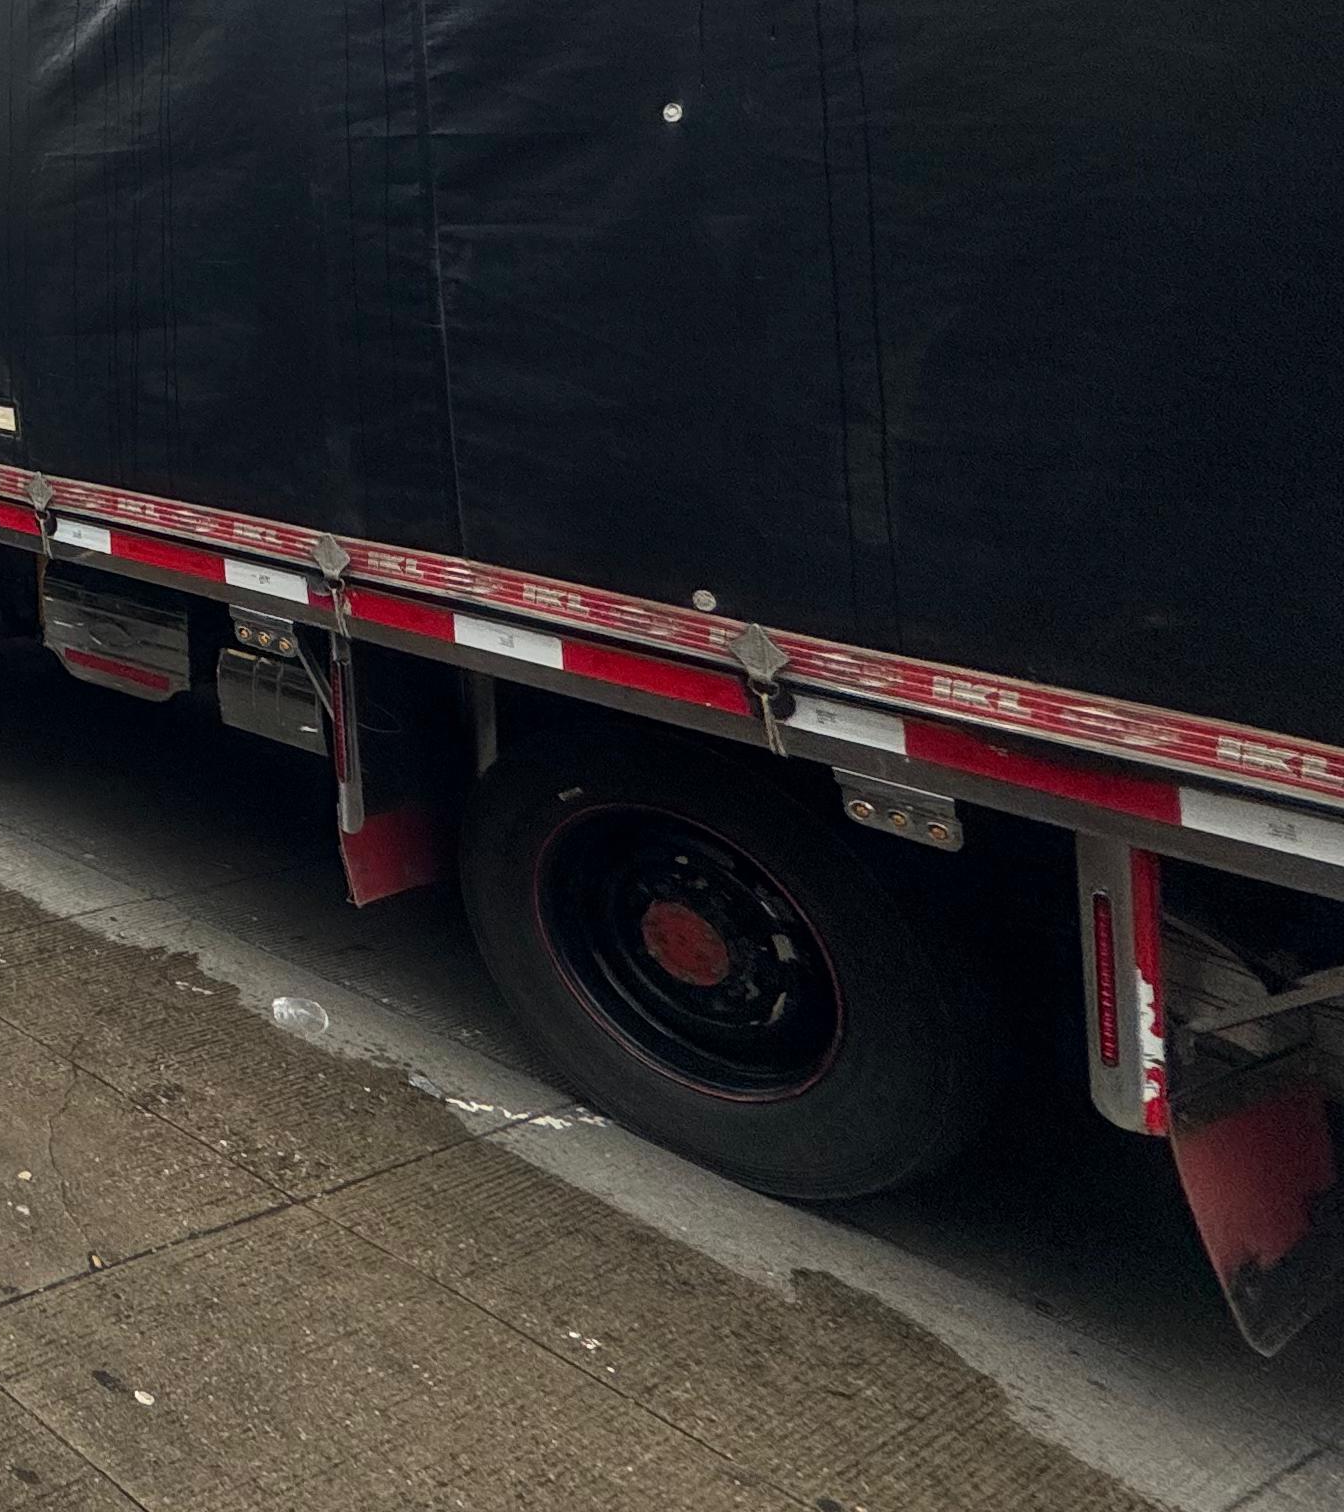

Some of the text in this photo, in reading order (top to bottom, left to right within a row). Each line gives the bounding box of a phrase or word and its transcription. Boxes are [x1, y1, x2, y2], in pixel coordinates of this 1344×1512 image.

[368, 551, 424, 580] IKL
[523, 583, 590, 616] IKL
[933, 675, 1032, 718] IKL
[1216, 736, 1344, 787] IKL
